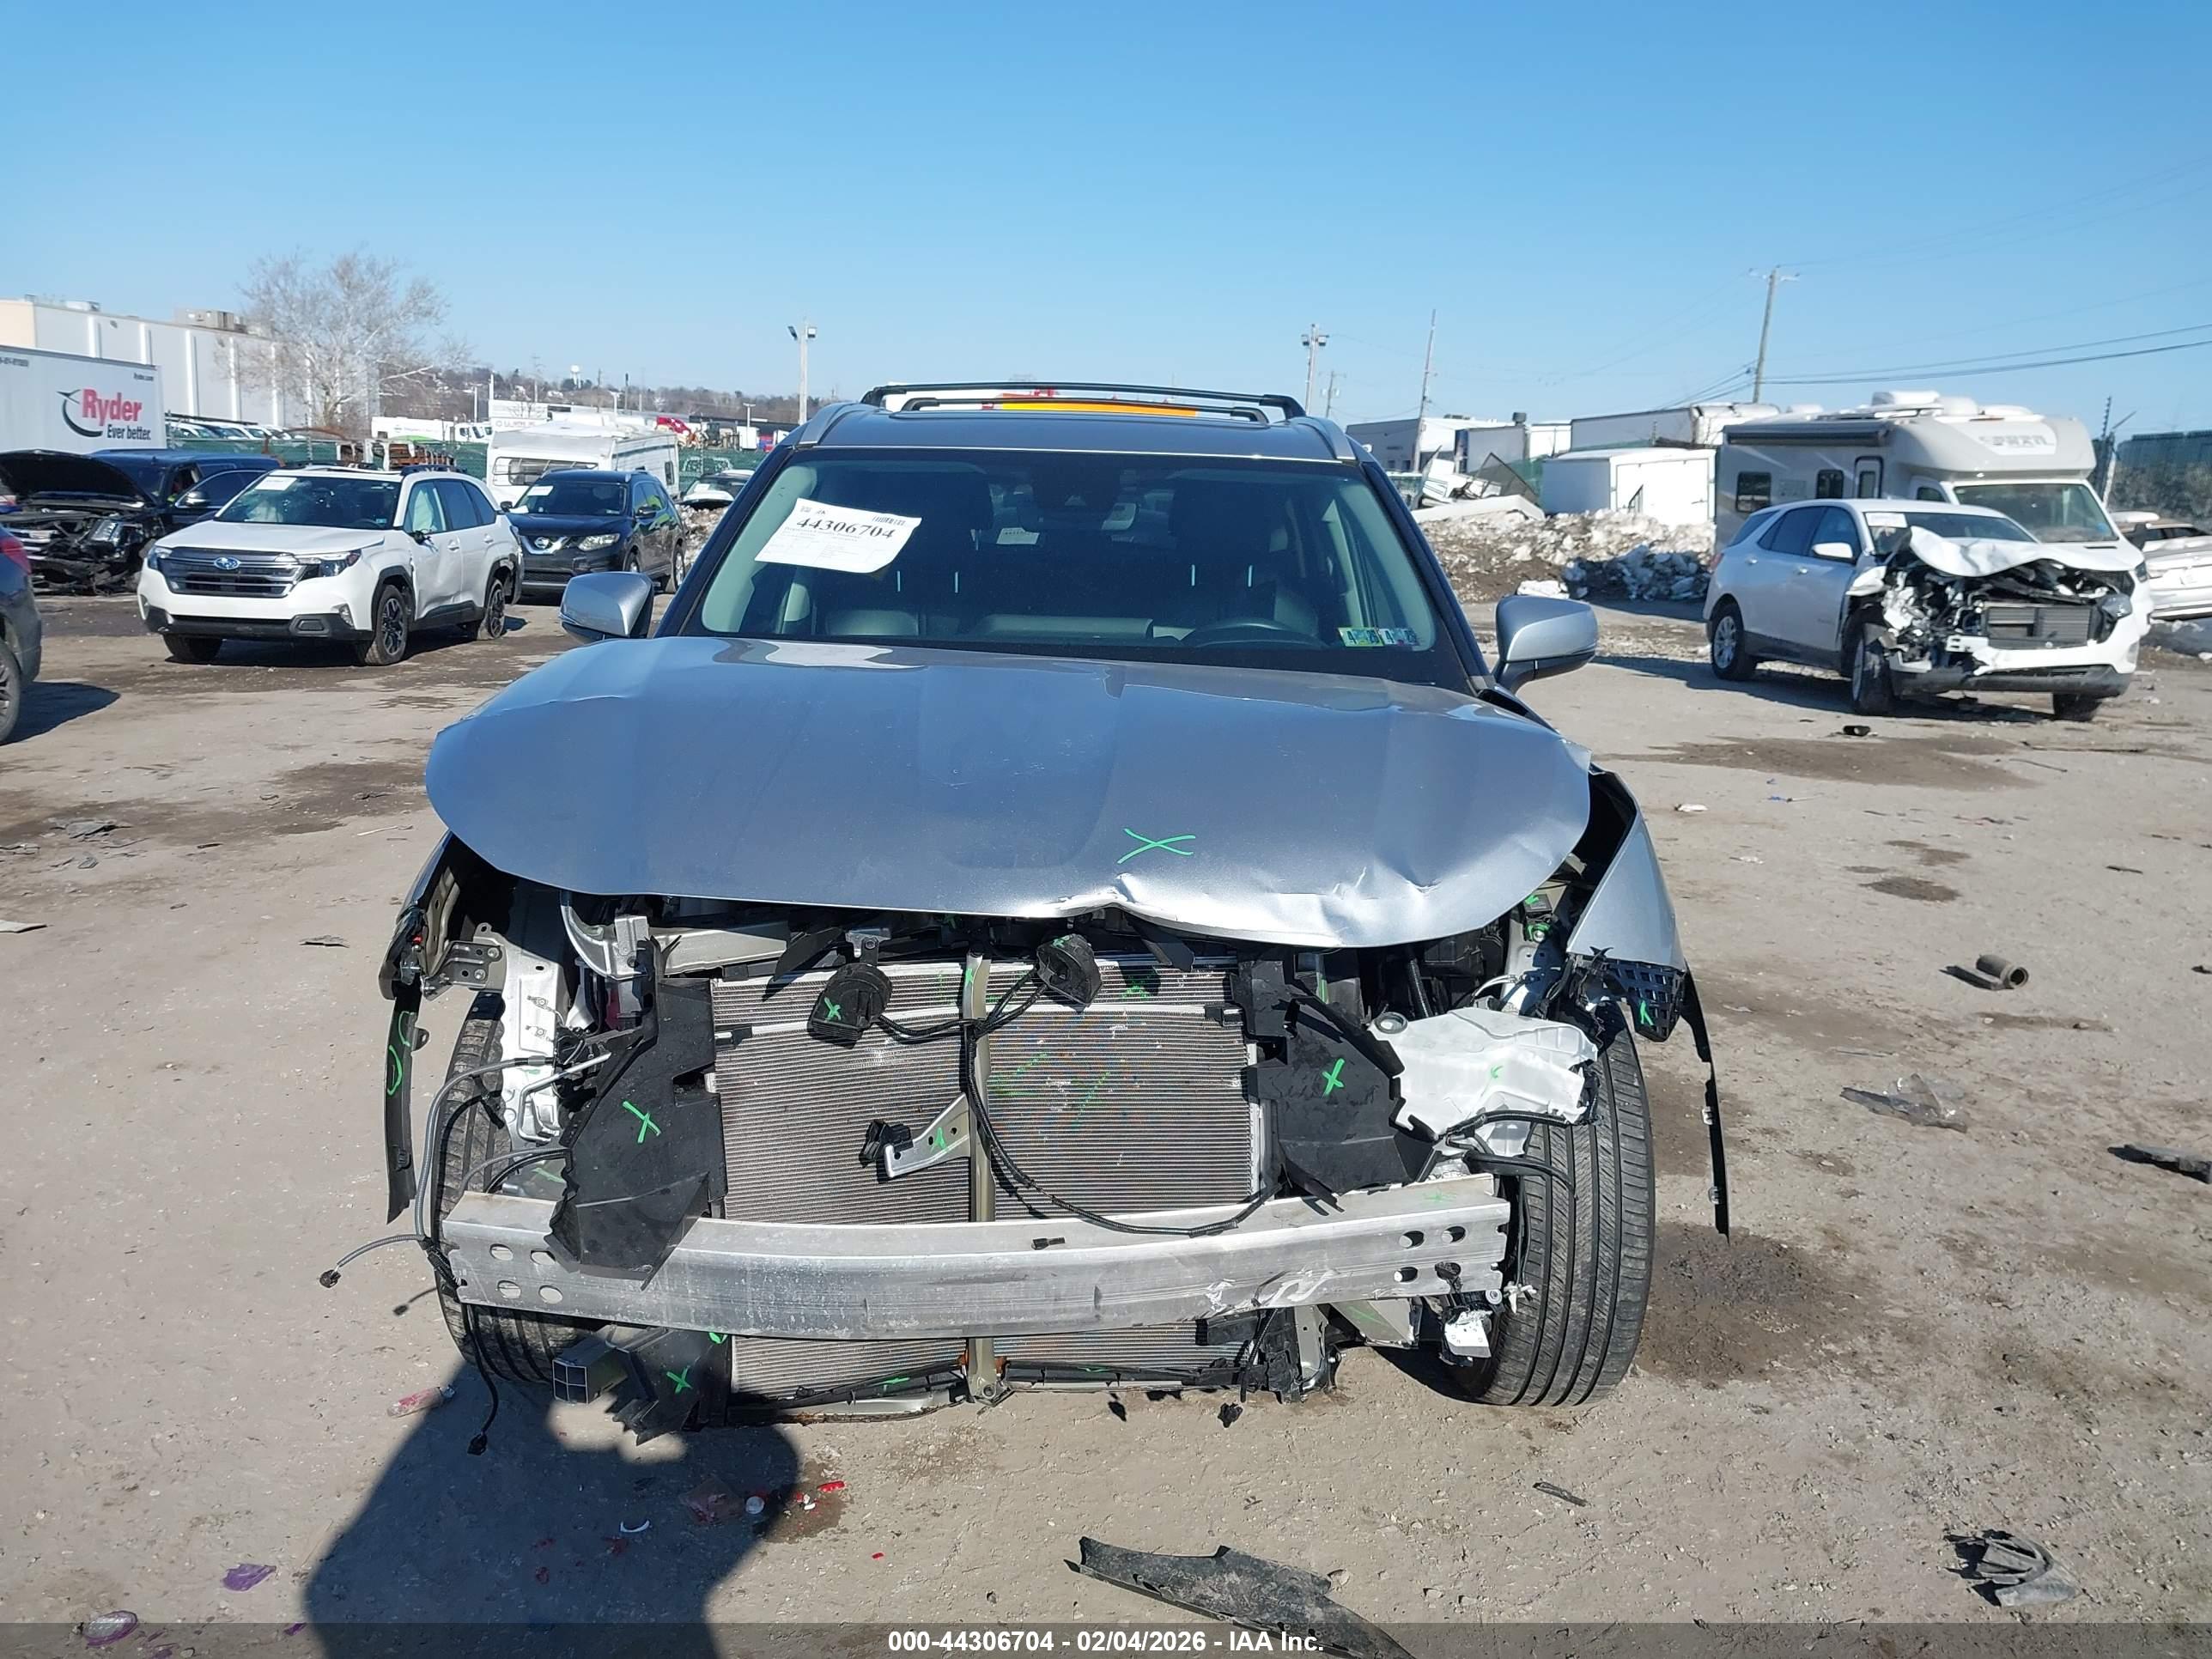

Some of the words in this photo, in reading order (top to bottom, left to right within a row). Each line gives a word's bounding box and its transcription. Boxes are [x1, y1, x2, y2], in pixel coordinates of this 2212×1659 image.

[82, 388, 143, 427] Ryder
[106, 423, 125, 440] Ever
[126, 425, 152, 441] better.
[796, 518, 896, 539] 44306704
